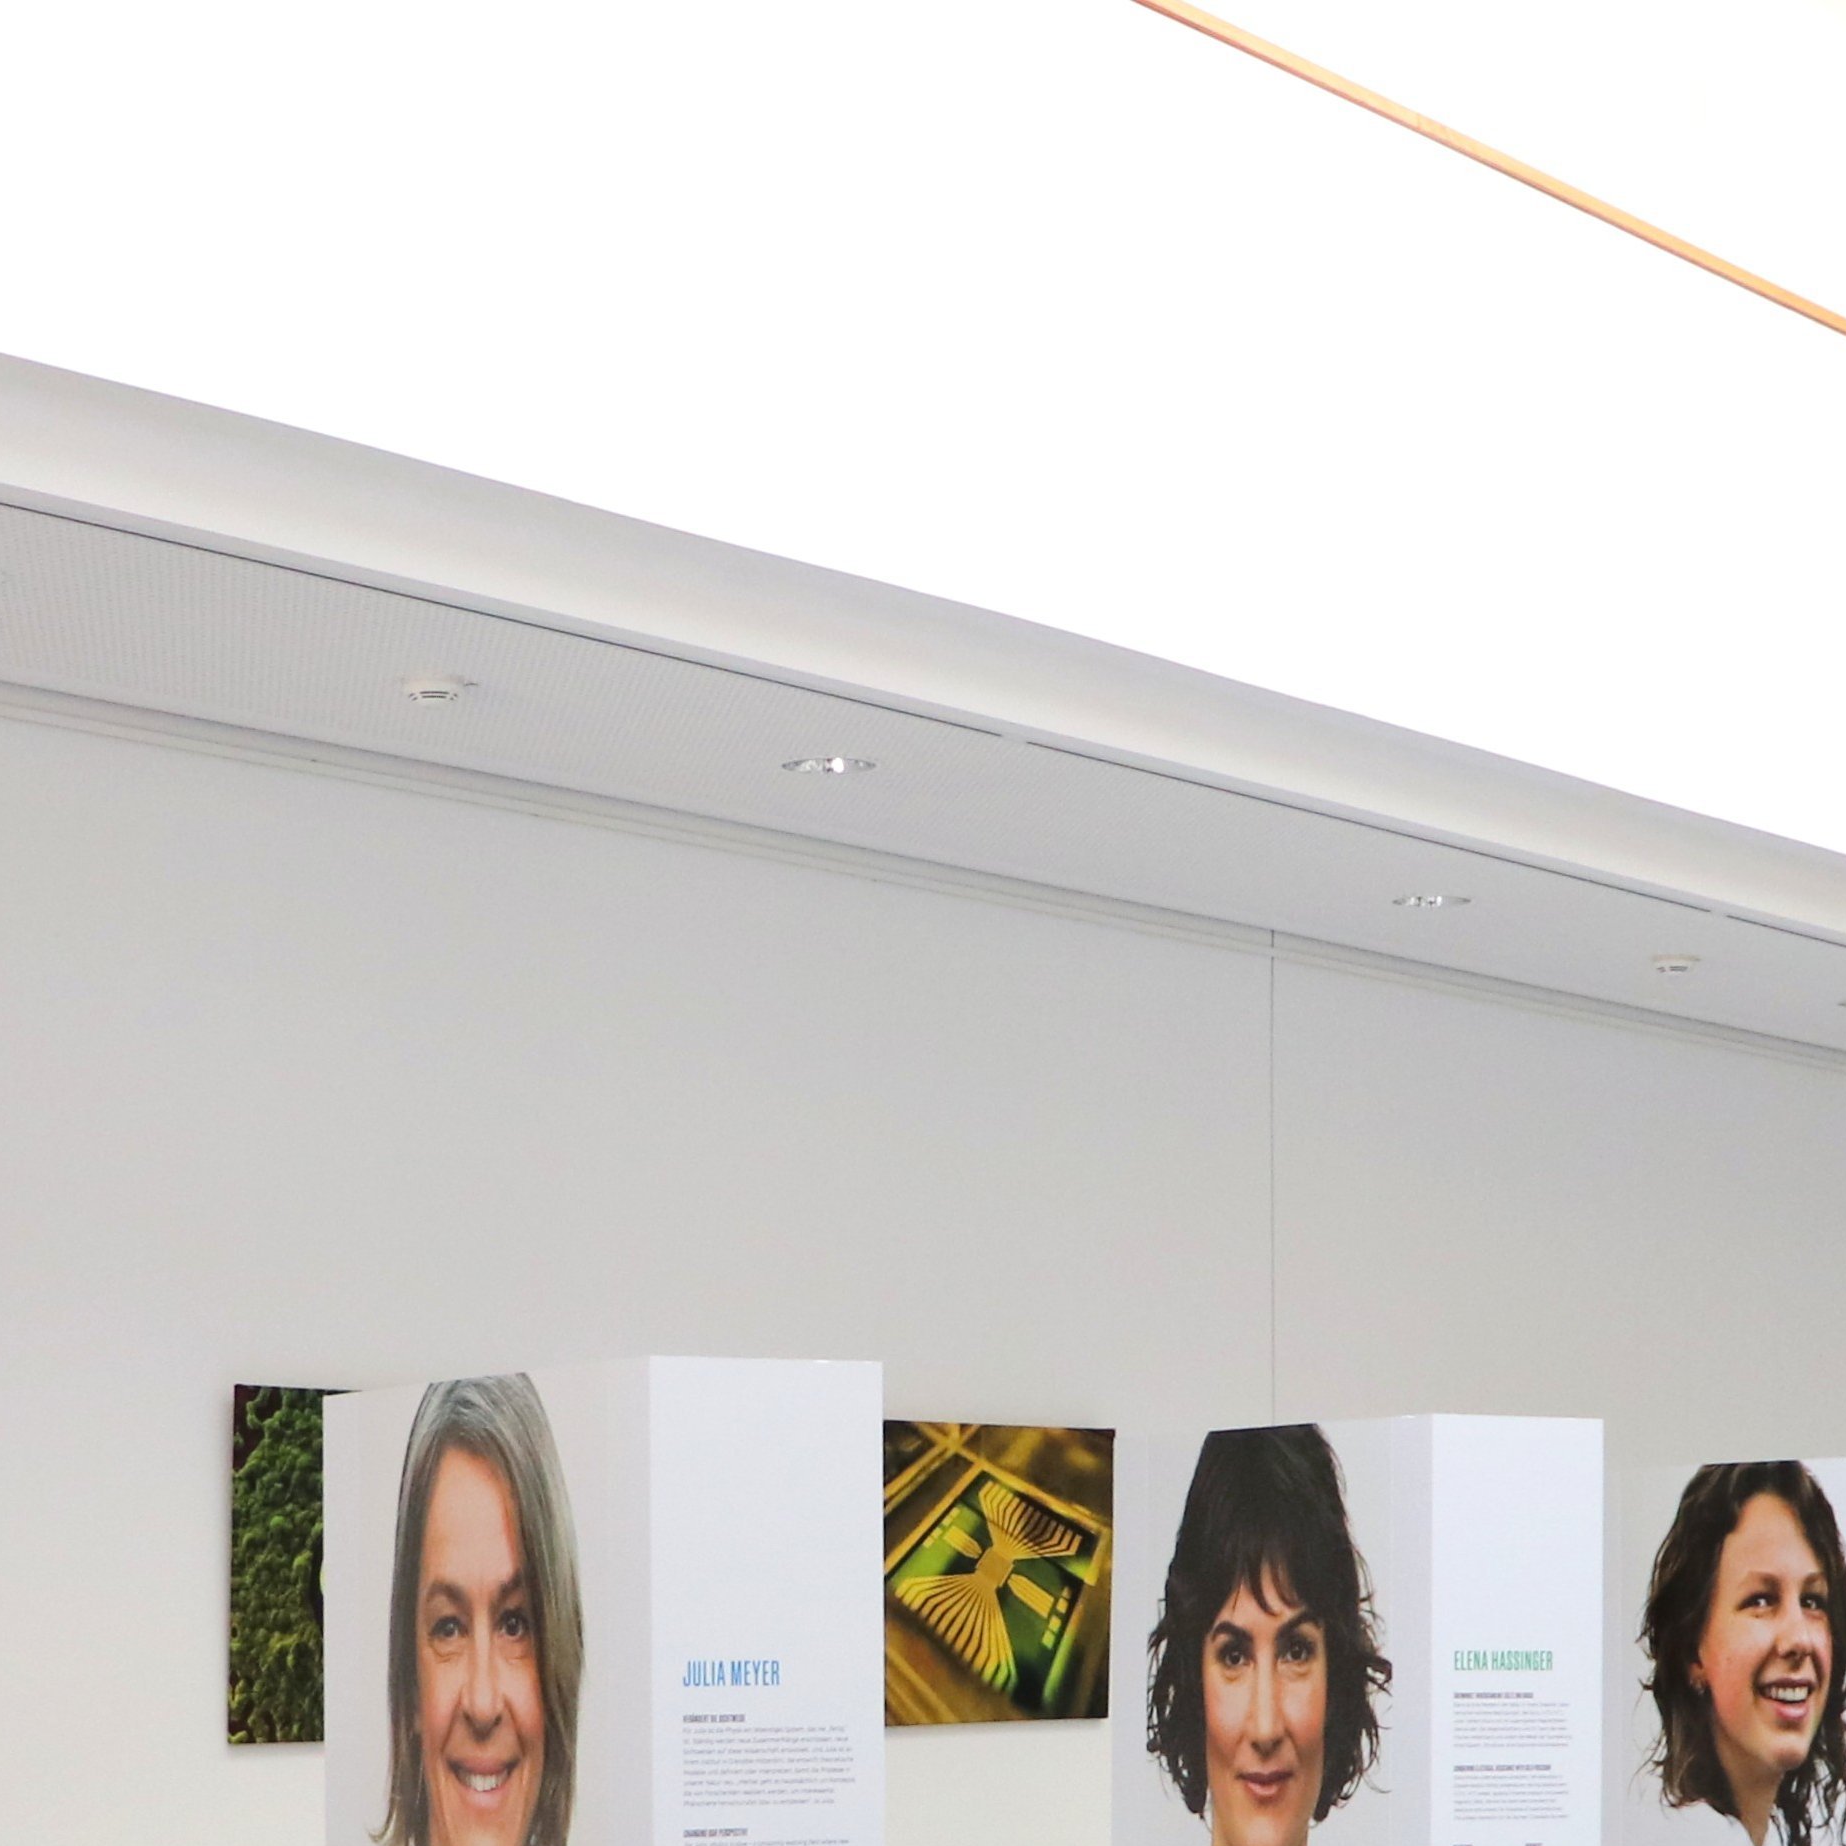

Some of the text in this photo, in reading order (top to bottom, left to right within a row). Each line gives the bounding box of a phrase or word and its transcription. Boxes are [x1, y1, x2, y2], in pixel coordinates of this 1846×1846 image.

[1454, 1651, 1553, 1671] ELENA HASSINGER
[682, 1660, 780, 1687] JULIA MEYER
